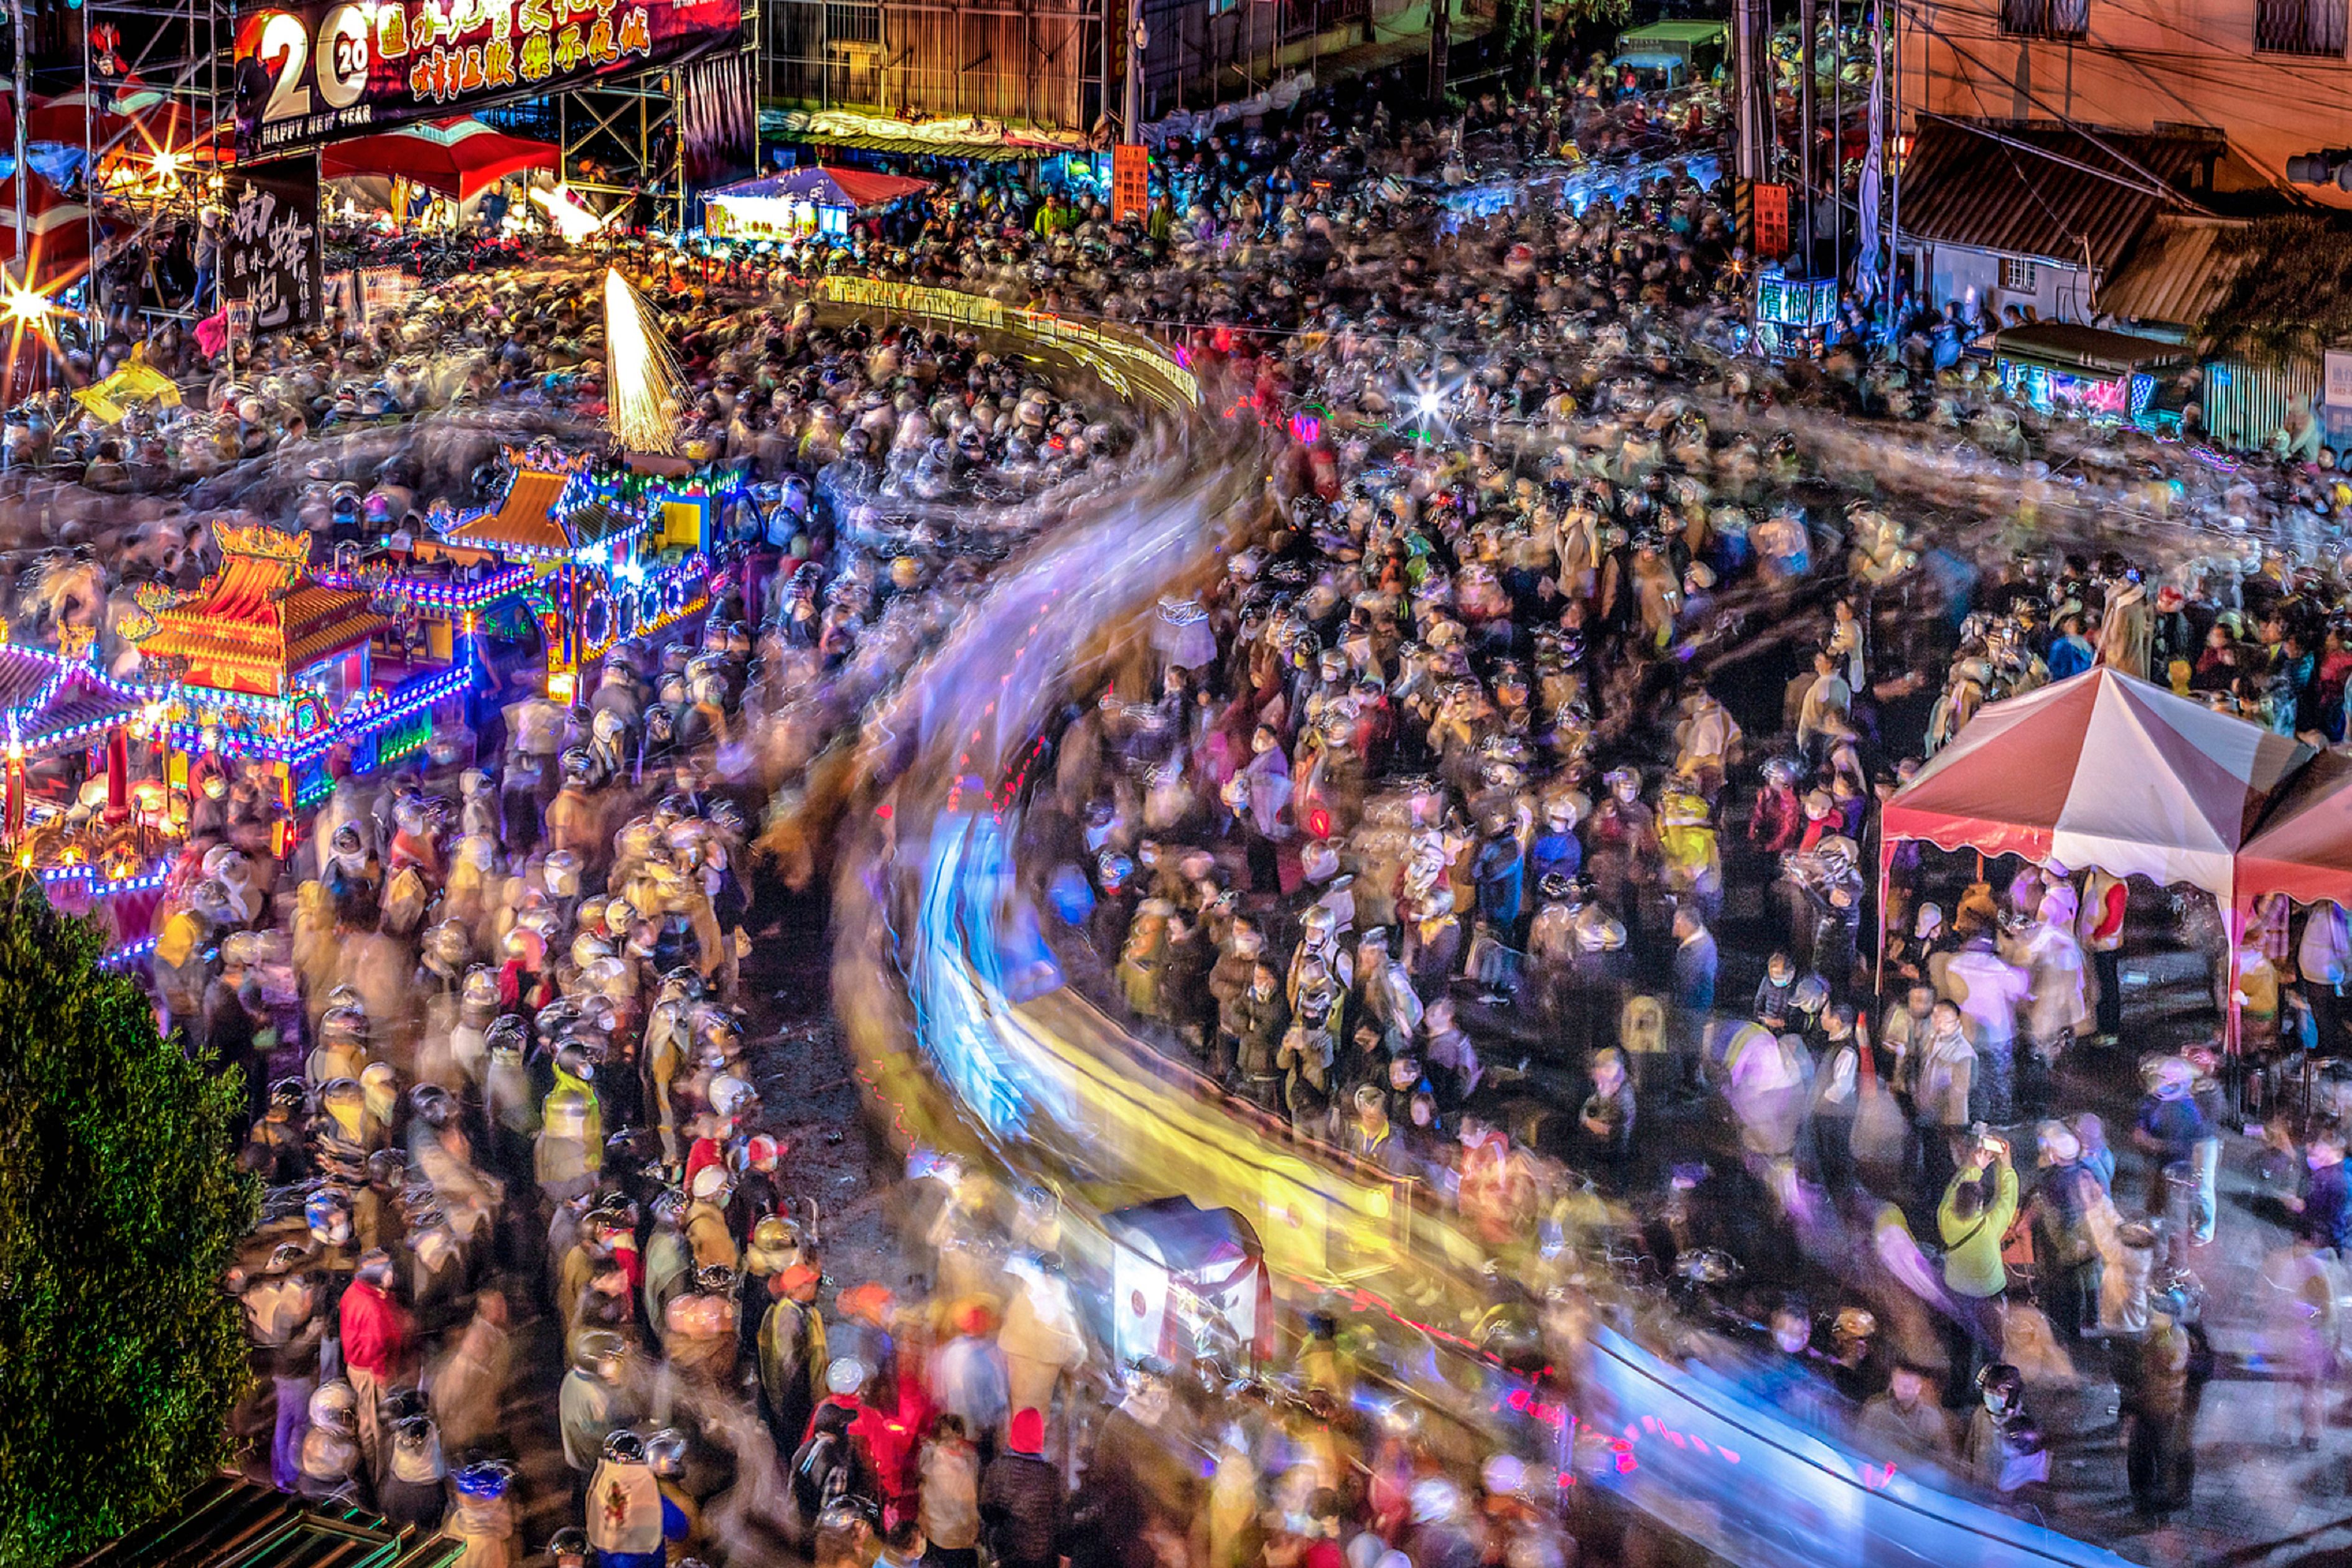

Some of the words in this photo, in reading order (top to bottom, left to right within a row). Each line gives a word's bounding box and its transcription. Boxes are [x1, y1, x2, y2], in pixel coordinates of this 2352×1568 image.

[338, 40, 368, 74] 20
[262, 119, 303, 145] HAPPY
[307, 112, 336, 134] NEW
[338, 104, 372, 127] YEAR
[1758, 279, 1809, 324] 檳榔
